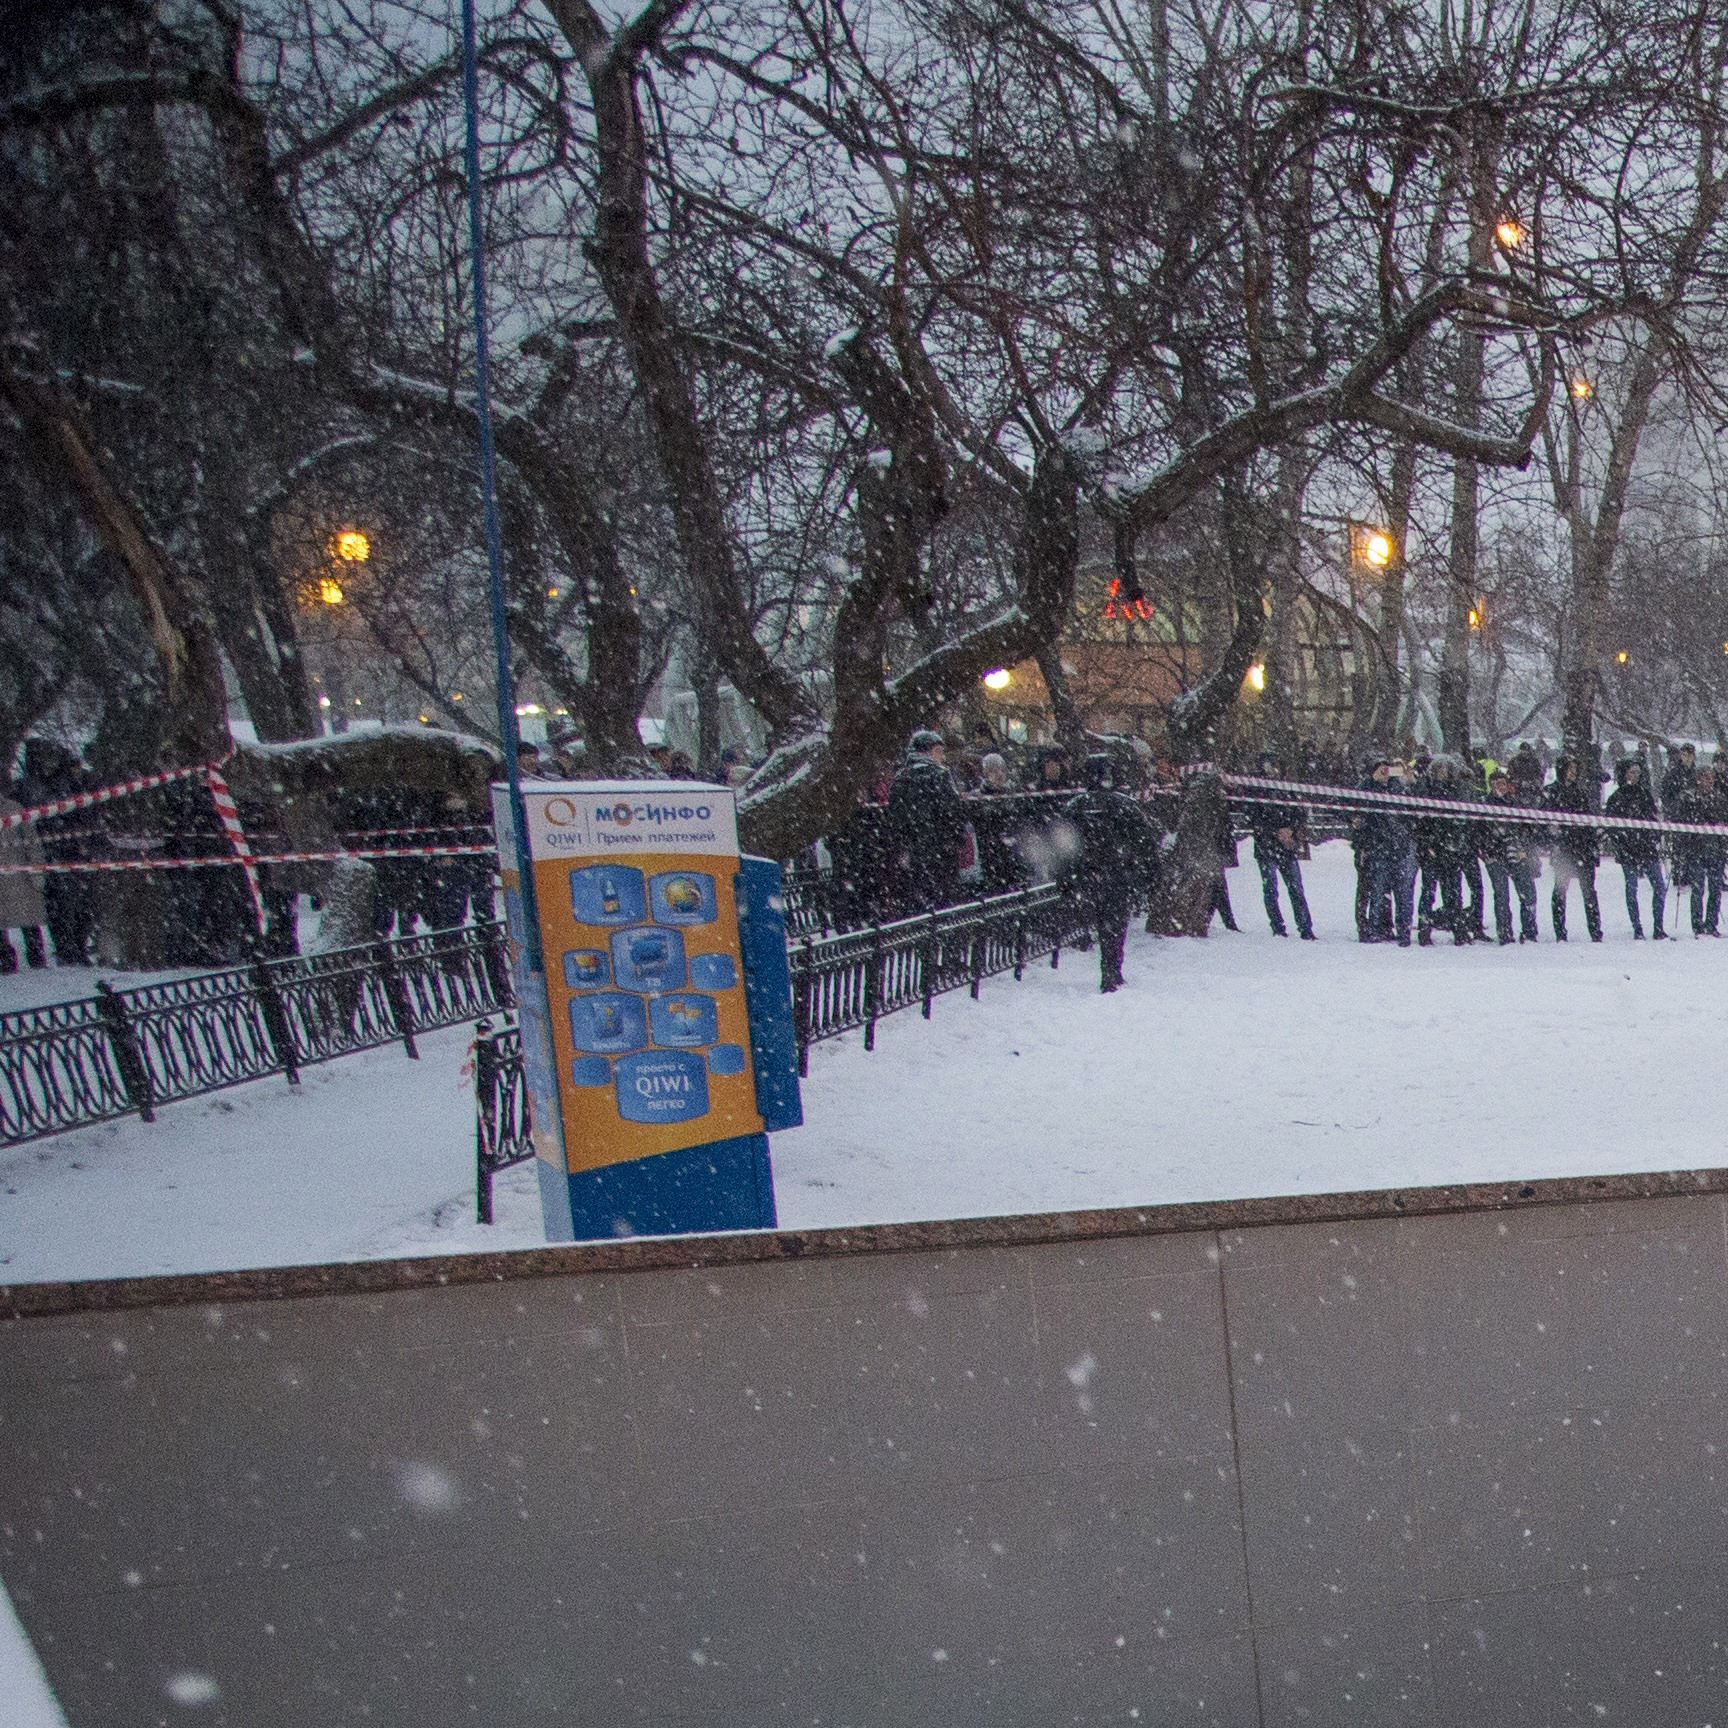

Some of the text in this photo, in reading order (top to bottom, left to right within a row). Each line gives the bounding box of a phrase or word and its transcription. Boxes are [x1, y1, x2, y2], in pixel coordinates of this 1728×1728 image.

[547, 832, 582, 846] QIWI
[597, 831, 717, 846] Прием платежей
[635, 1075, 690, 1099] QIWI
